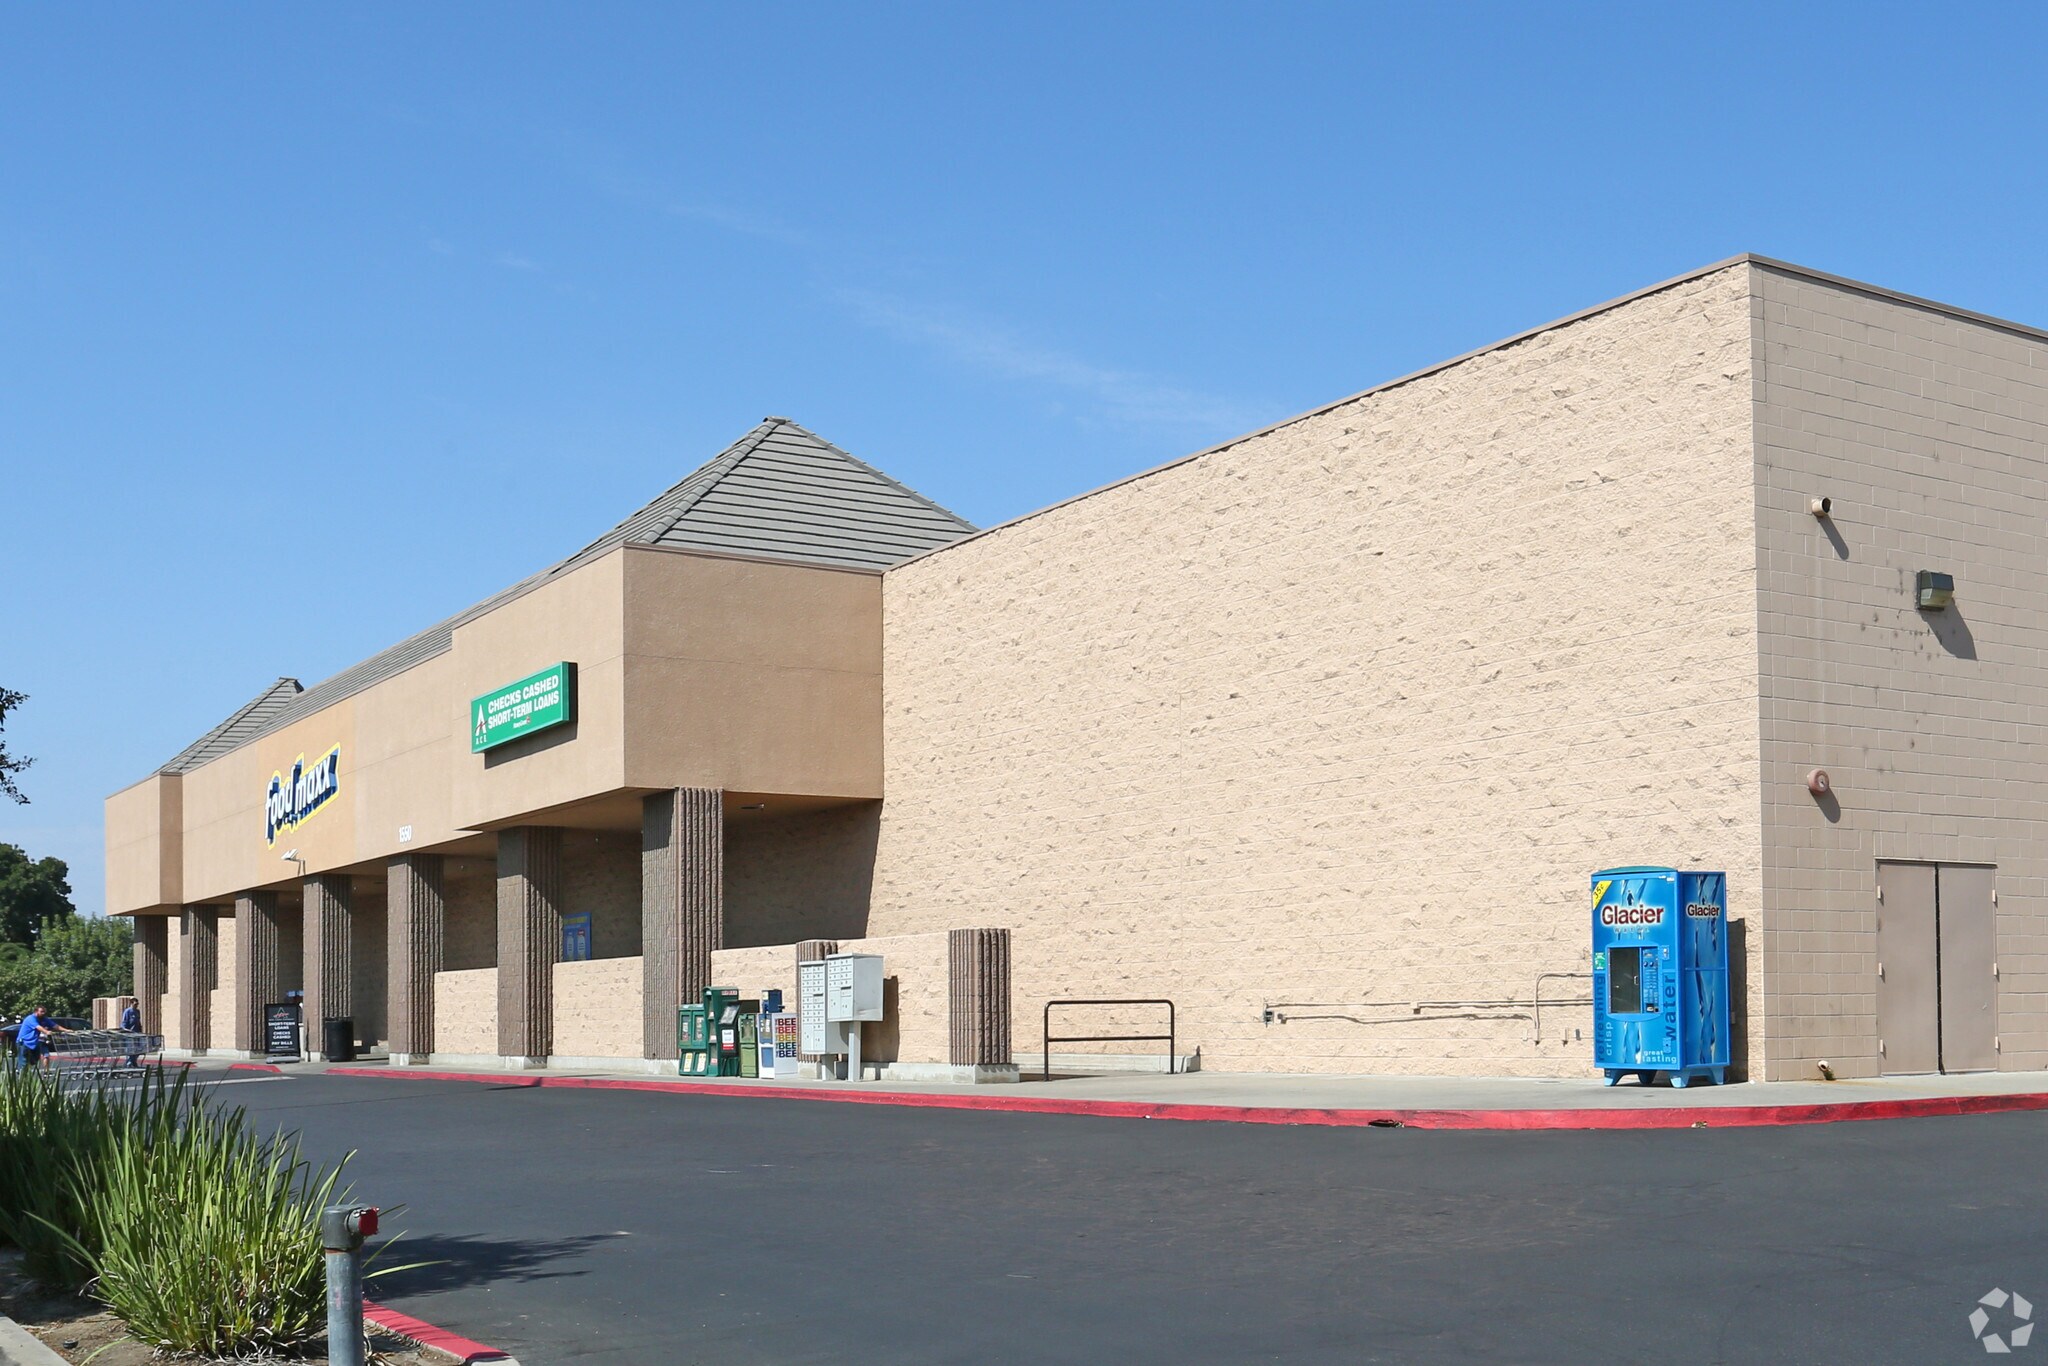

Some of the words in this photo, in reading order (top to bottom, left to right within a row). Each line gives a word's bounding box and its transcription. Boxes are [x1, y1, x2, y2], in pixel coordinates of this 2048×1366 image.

[488, 689, 522, 714] CHECKS
[523, 674, 559, 700] CASHED
[488, 700, 533, 729] SHORT-TERM
[534, 690, 559, 711] LOANS
[1601, 904, 1664, 925] Glacier
[1687, 904, 1720, 916] Glacier
[1663, 975, 1677, 1041] water
[778, 1018, 797, 1026] BEE
[778, 1026, 797, 1034] BEE
[1605, 1022, 1614, 1055] crisp
[779, 1042, 797, 1050] BEE
[779, 1050, 797, 1058] BEE
[1642, 1055, 1677, 1064] tasting
